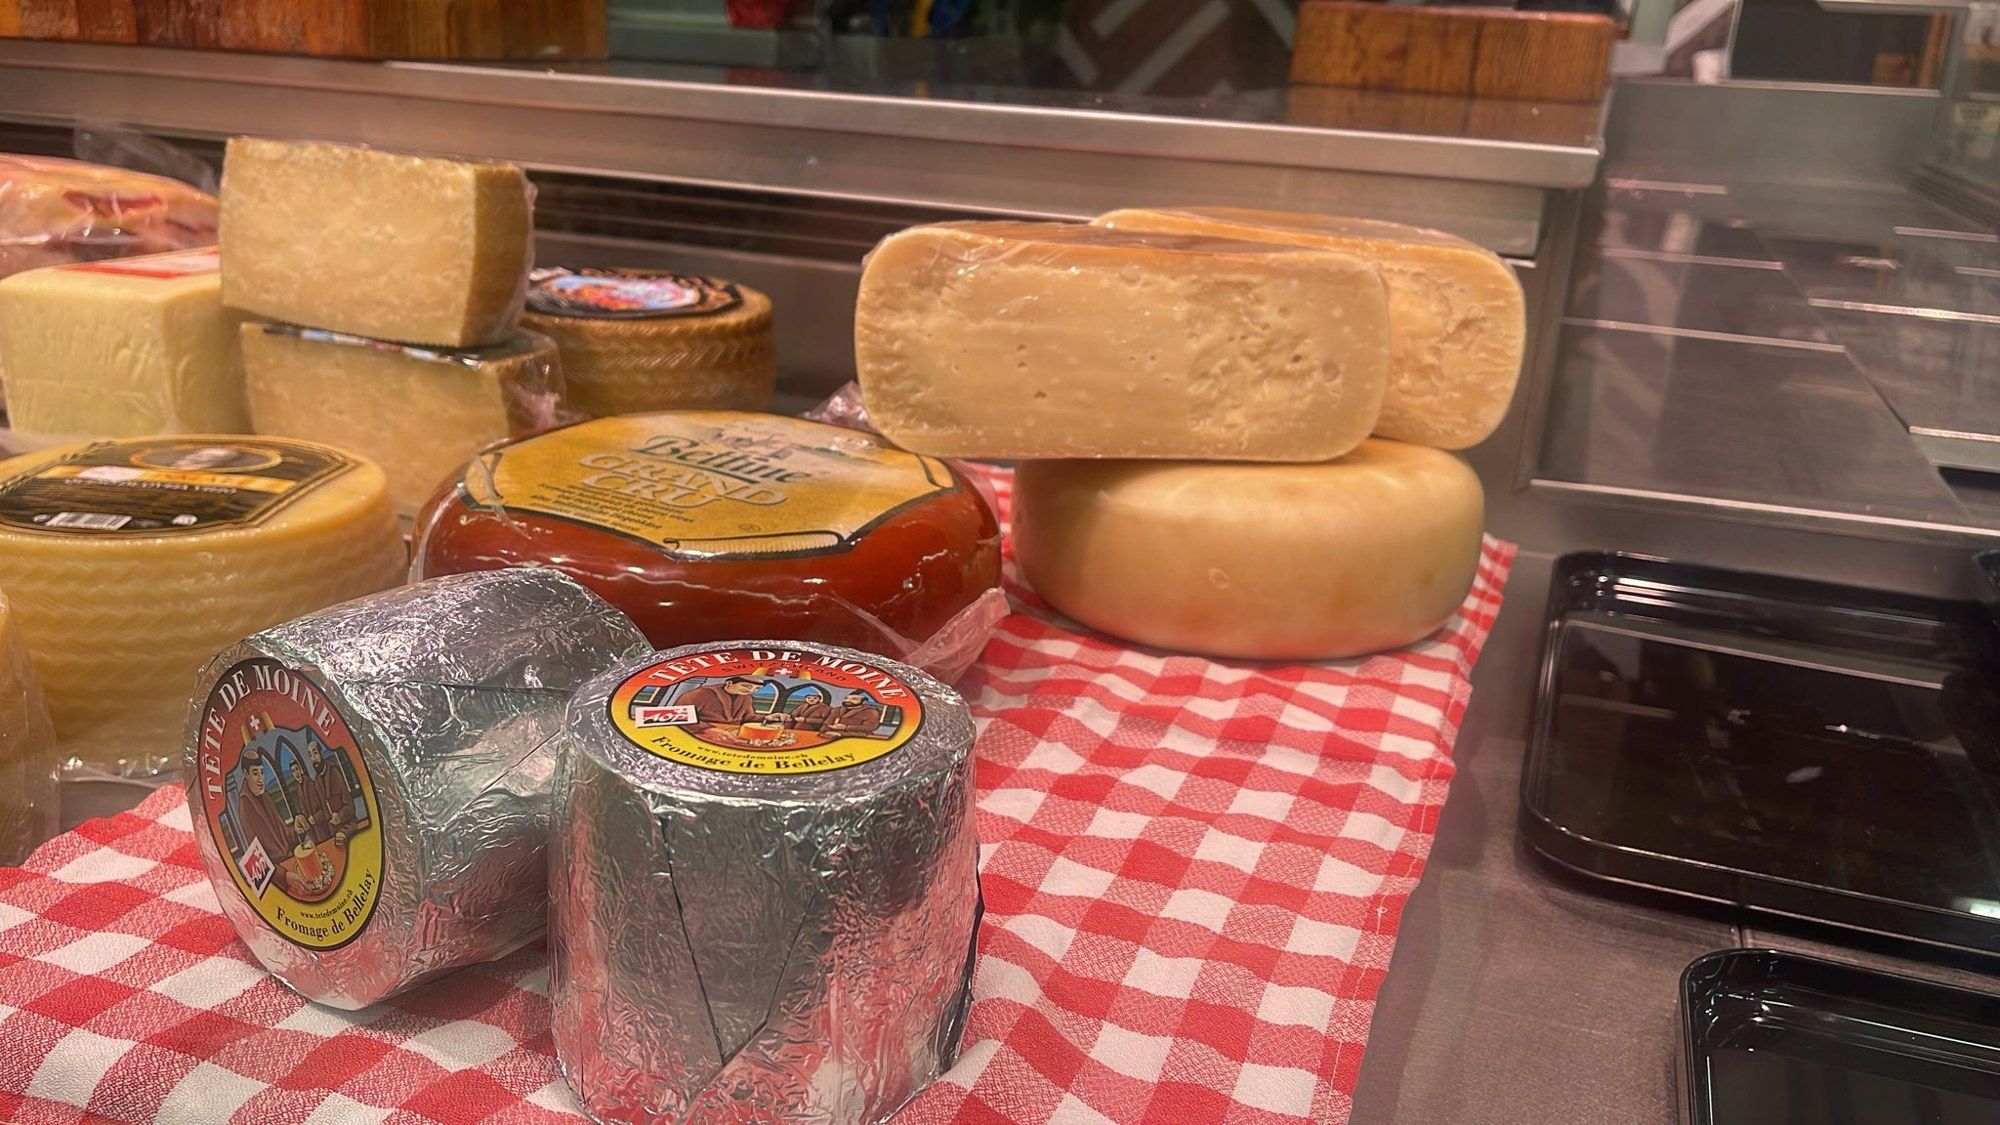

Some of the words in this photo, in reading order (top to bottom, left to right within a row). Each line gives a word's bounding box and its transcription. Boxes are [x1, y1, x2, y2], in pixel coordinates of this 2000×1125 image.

[580, 453, 787, 506] GRAND
[582, 472, 722, 508] CRU
[751, 651, 802, 661] DE
[813, 656, 908, 699] MOINE
[202, 708, 226, 800] TÊTE
[219, 670, 251, 712] DE
[252, 665, 336, 738] MOINE
[643, 711, 689, 725] AOP
[651, 736, 731, 766] Fromage
[739, 760, 765, 769] de
[774, 753, 854, 769] Bellelay
[276, 906, 329, 941] Fromage
[331, 918, 345, 935] de
[343, 869, 376, 925] Bellelay
